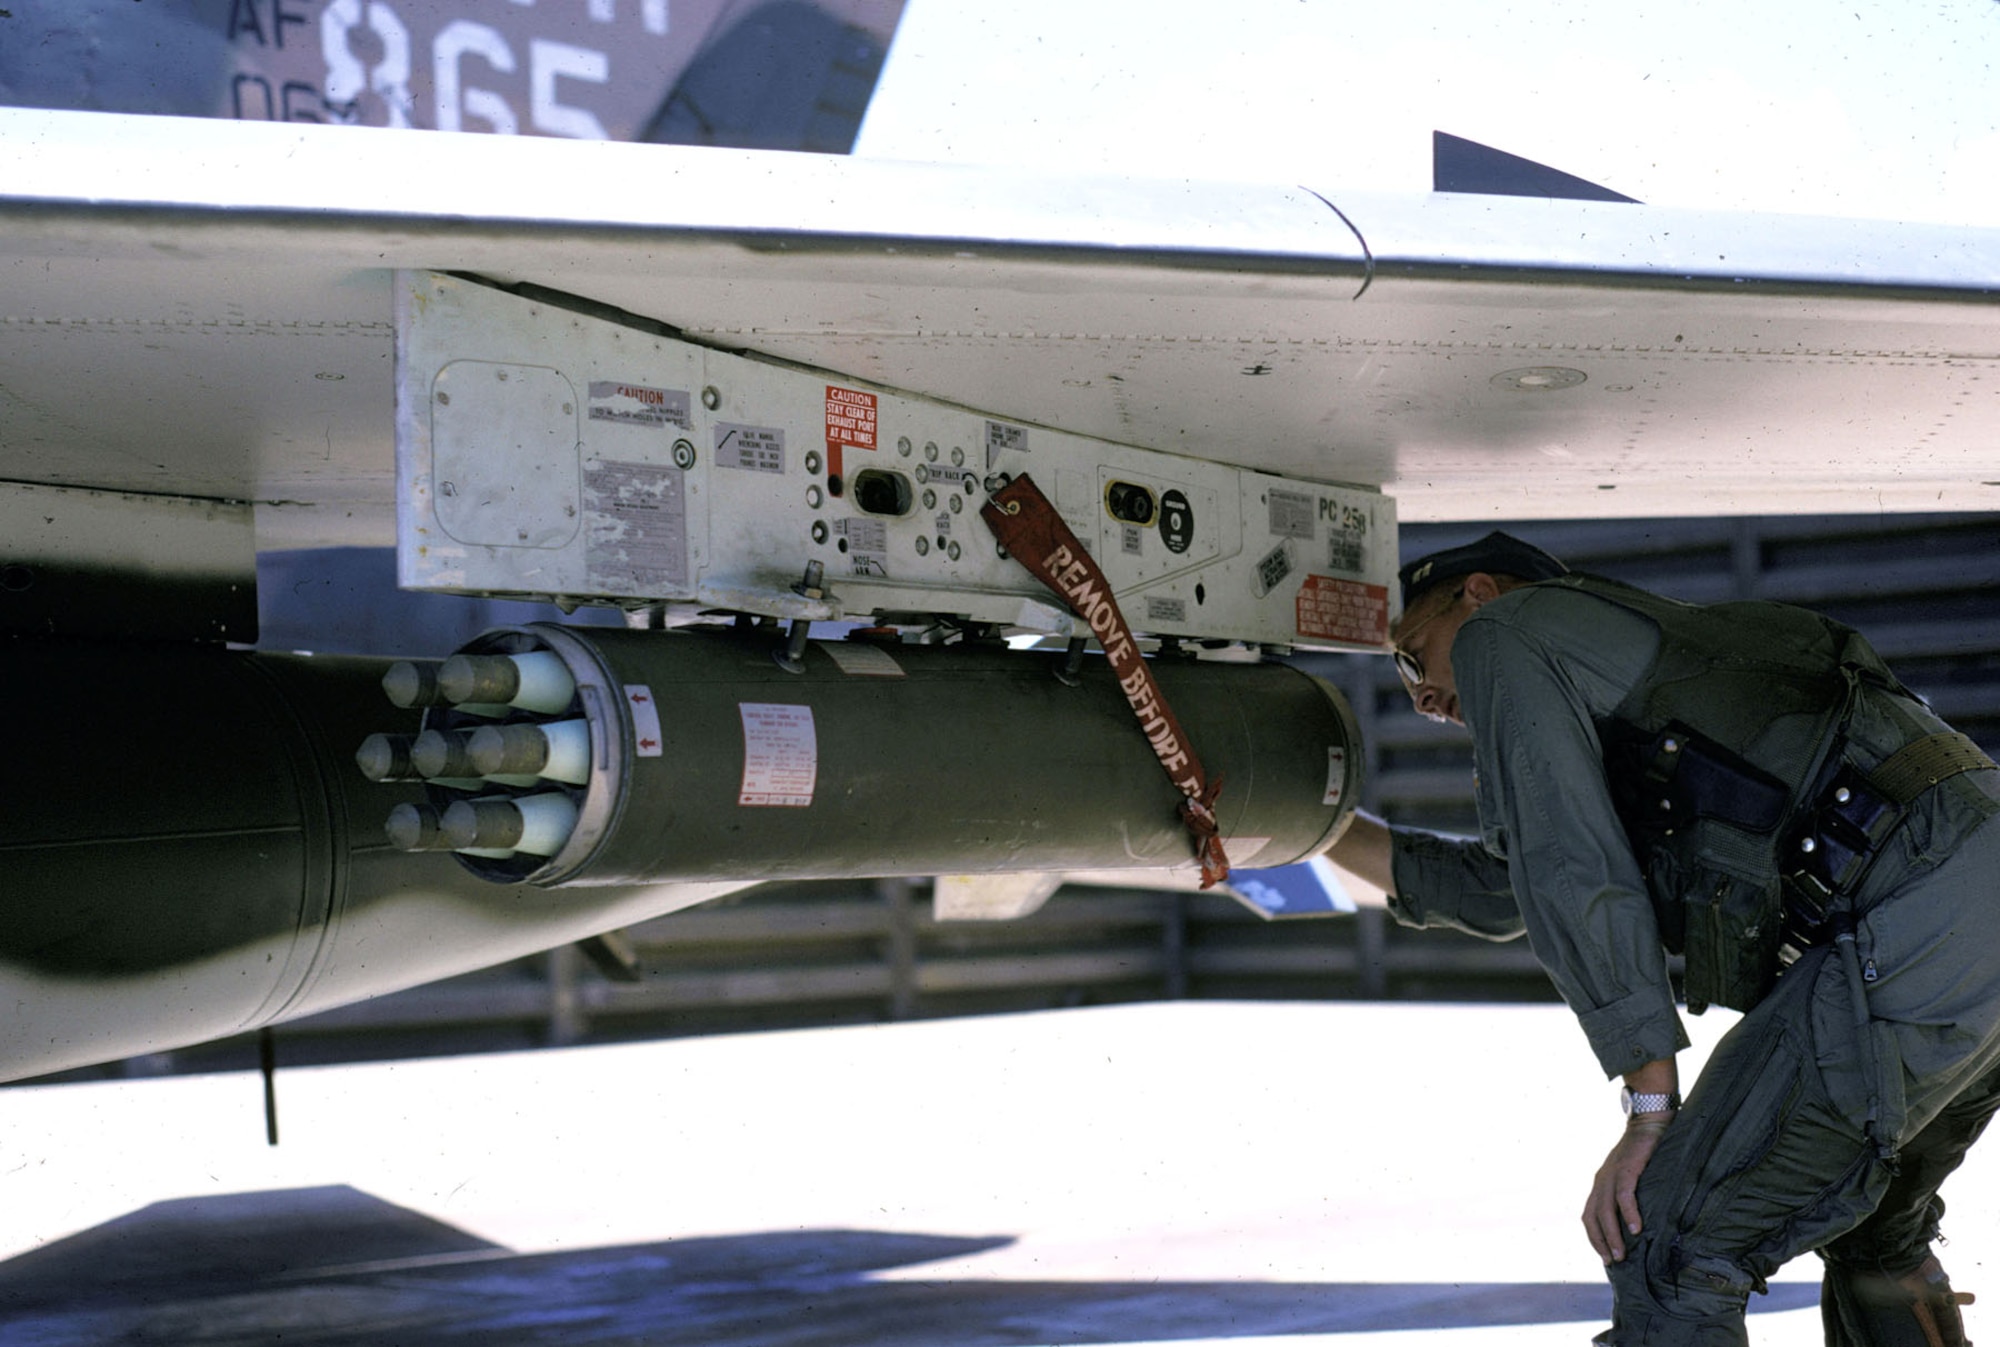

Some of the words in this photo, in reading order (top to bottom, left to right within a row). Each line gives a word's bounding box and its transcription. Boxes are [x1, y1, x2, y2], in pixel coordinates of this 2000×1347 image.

[617, 386, 664, 405] CAUTION
[831, 389, 872, 406] CAUTION
[827, 402, 844, 415] STAY
[845, 406, 865, 420] CLEAR
[866, 410, 876, 421] OF
[827, 414, 857, 429] EXHAUST
[857, 420, 875, 432] PORT
[830, 426, 839, 438] AT
[840, 428, 852, 441] ALL
[853, 430, 873, 444] TIMES
[944, 470, 960, 481] RACK
[1319, 497, 1337, 522] PC
[853, 555, 870, 566] NOSE
[1041, 544, 1132, 668] REMOVE
[1120, 666, 1189, 772] BEFORE
